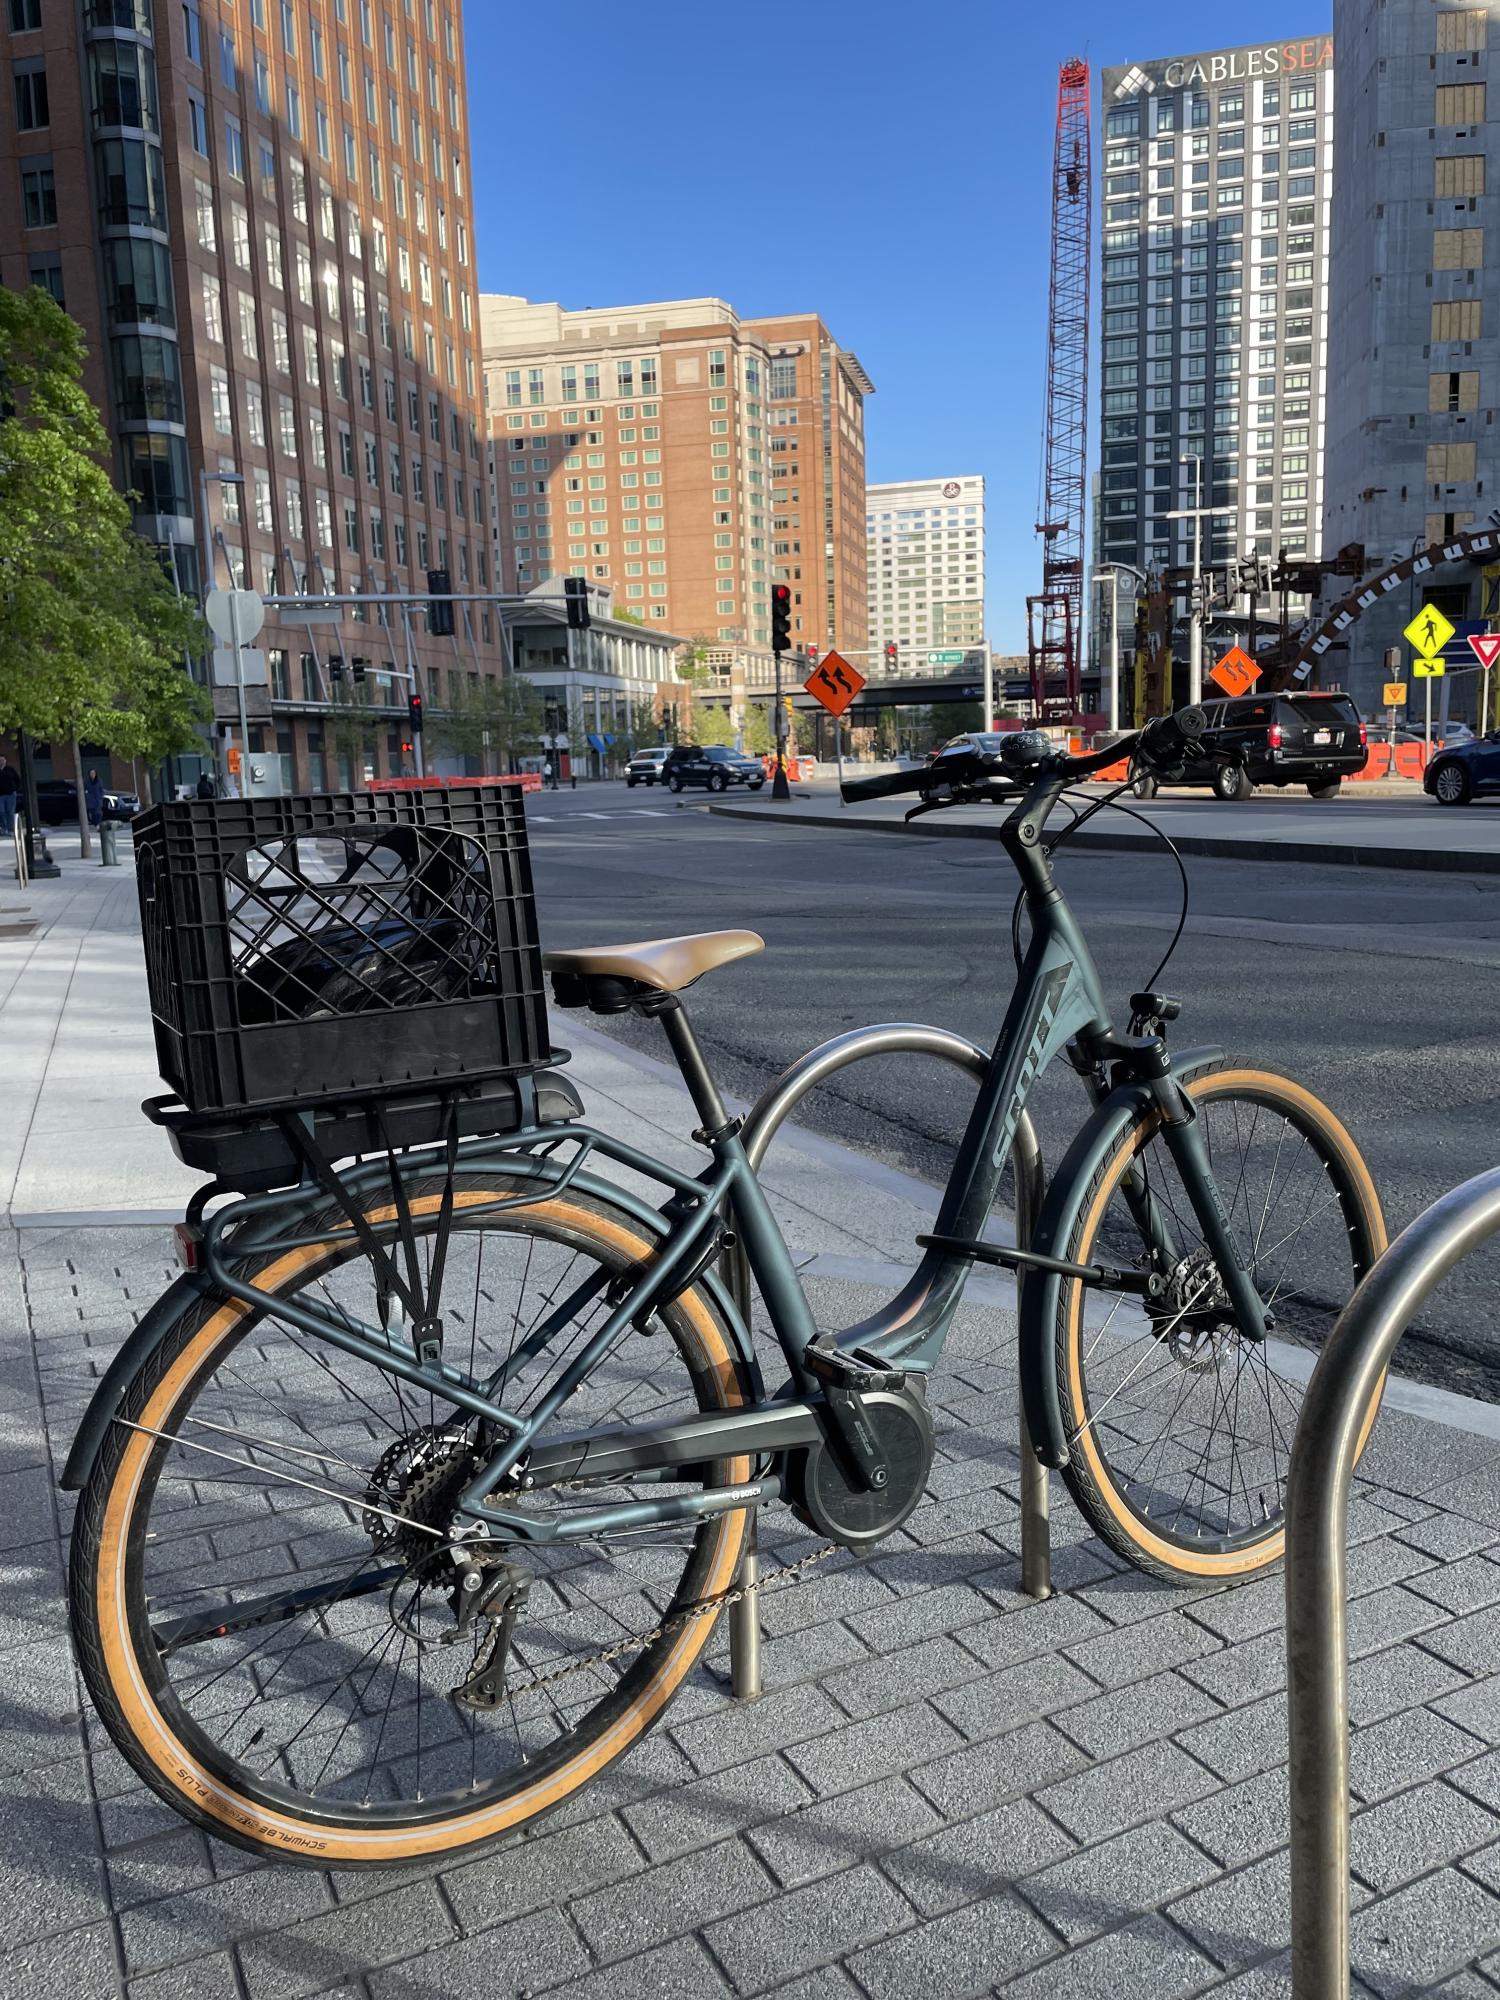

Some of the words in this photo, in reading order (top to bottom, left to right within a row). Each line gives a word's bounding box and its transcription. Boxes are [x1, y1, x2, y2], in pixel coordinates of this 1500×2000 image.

[1164, 48, 1279, 88] GABLES
[740, 1487, 761, 1498] BOSCH
[176, 1768, 209, 1797] PLUS
[258, 1826, 328, 1850] SCHWALBE
